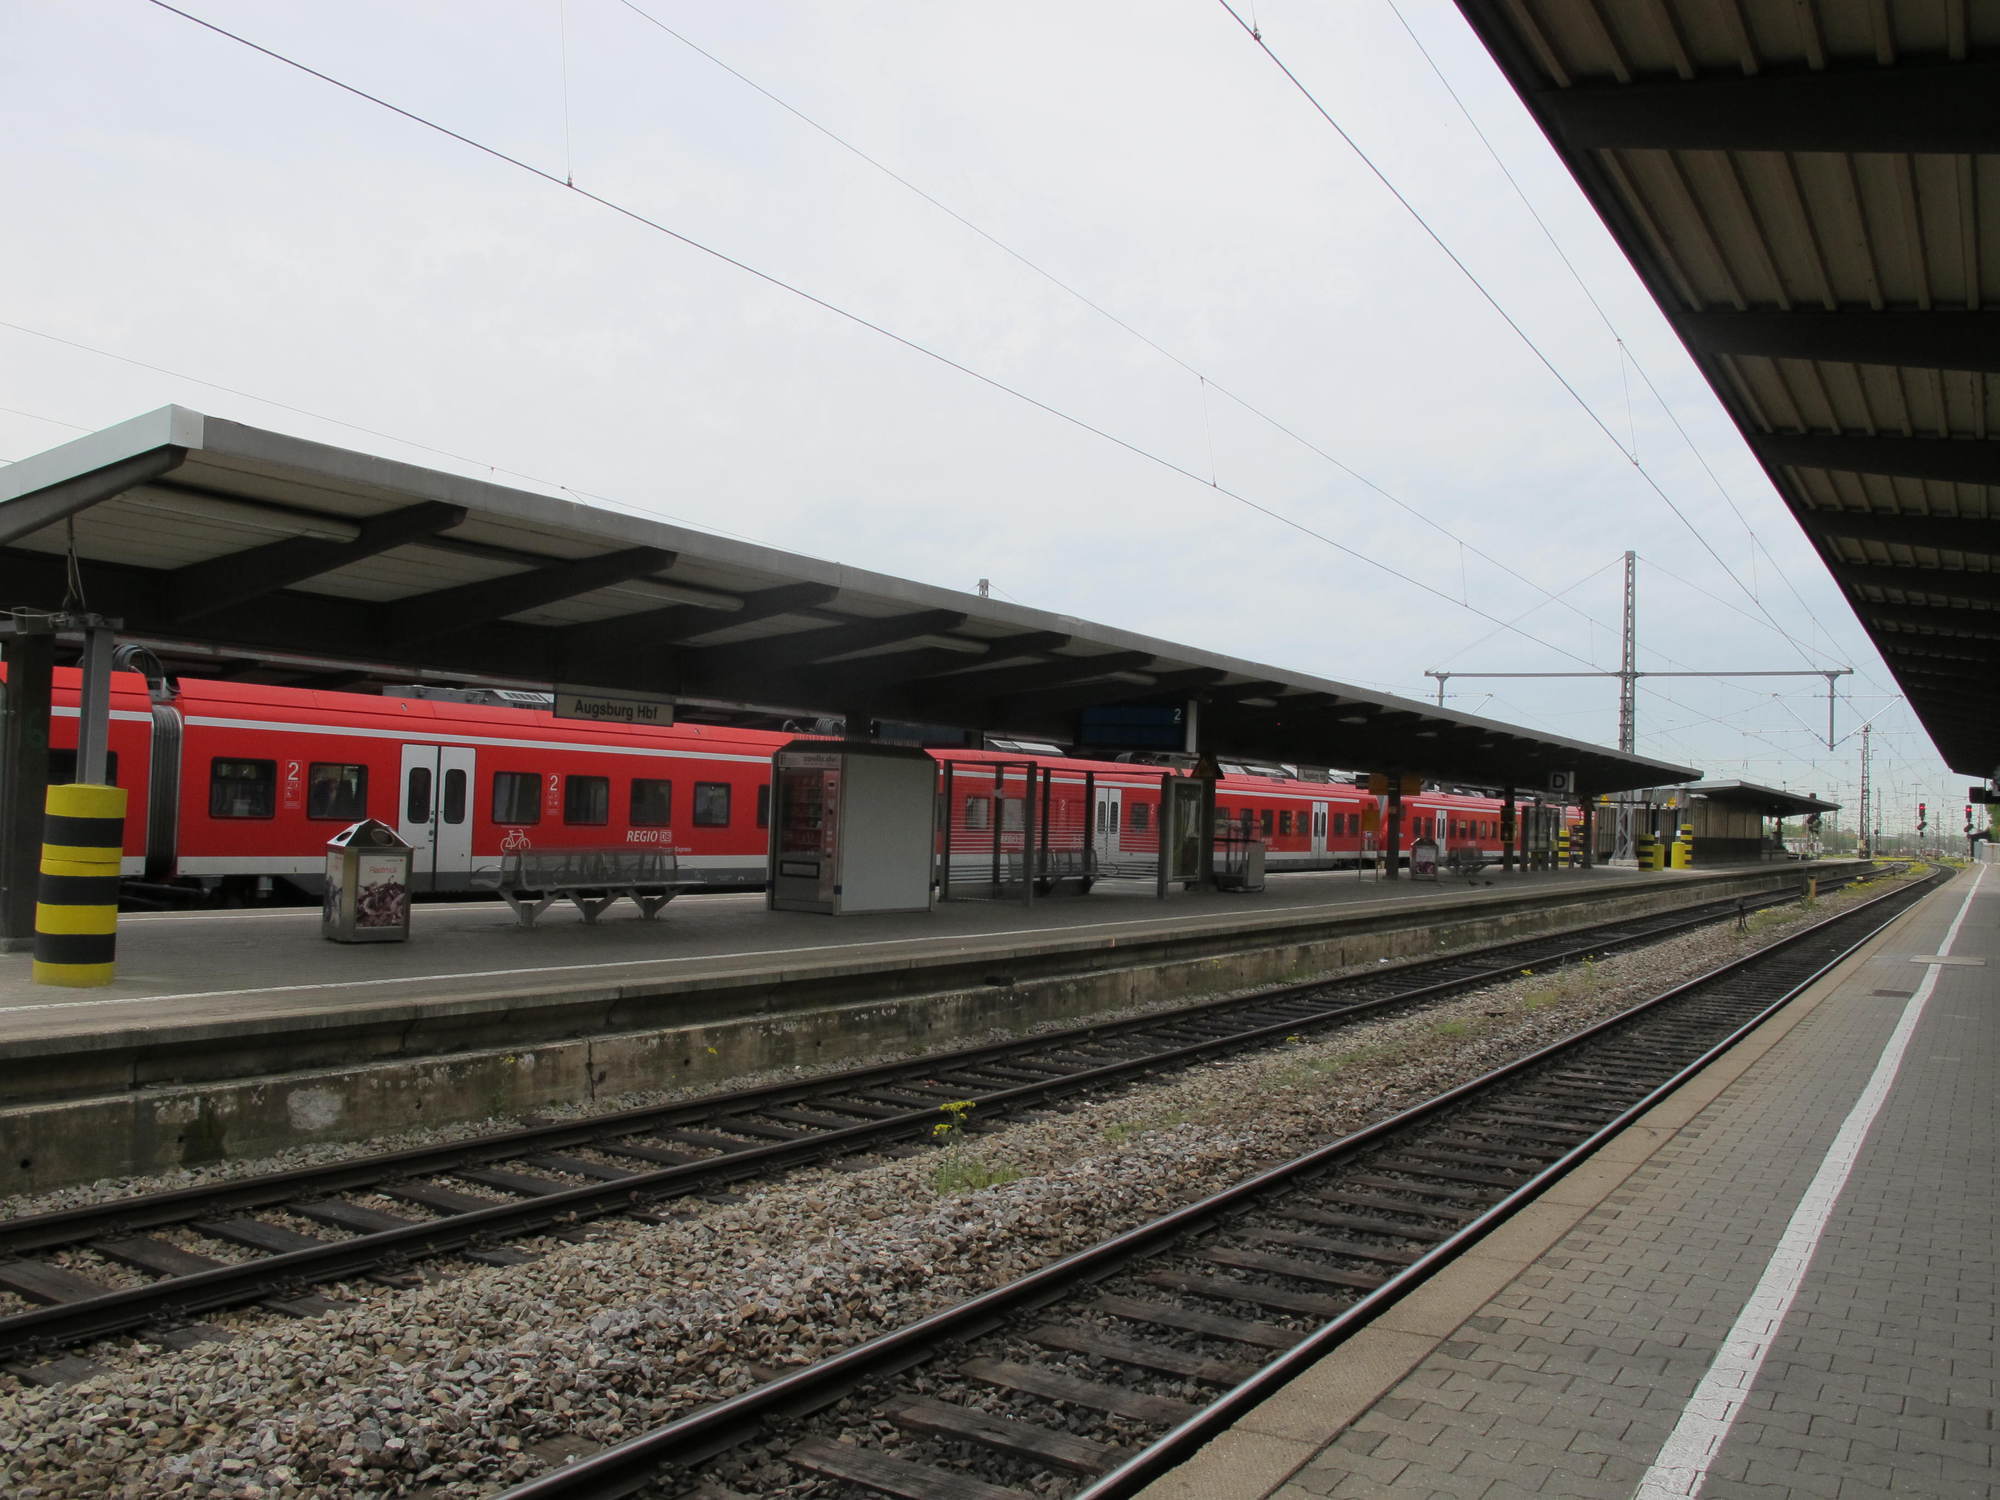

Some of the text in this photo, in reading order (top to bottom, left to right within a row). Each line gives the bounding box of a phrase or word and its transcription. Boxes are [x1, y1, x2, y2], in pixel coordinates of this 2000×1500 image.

[575, 699, 658, 721] Augsburg Hbf
[1173, 707, 1182, 721] 2
[287, 762, 299, 781] 2
[550, 775, 558, 791] 2
[1553, 774, 1565, 788] D
[626, 830, 658, 842] REGIO
